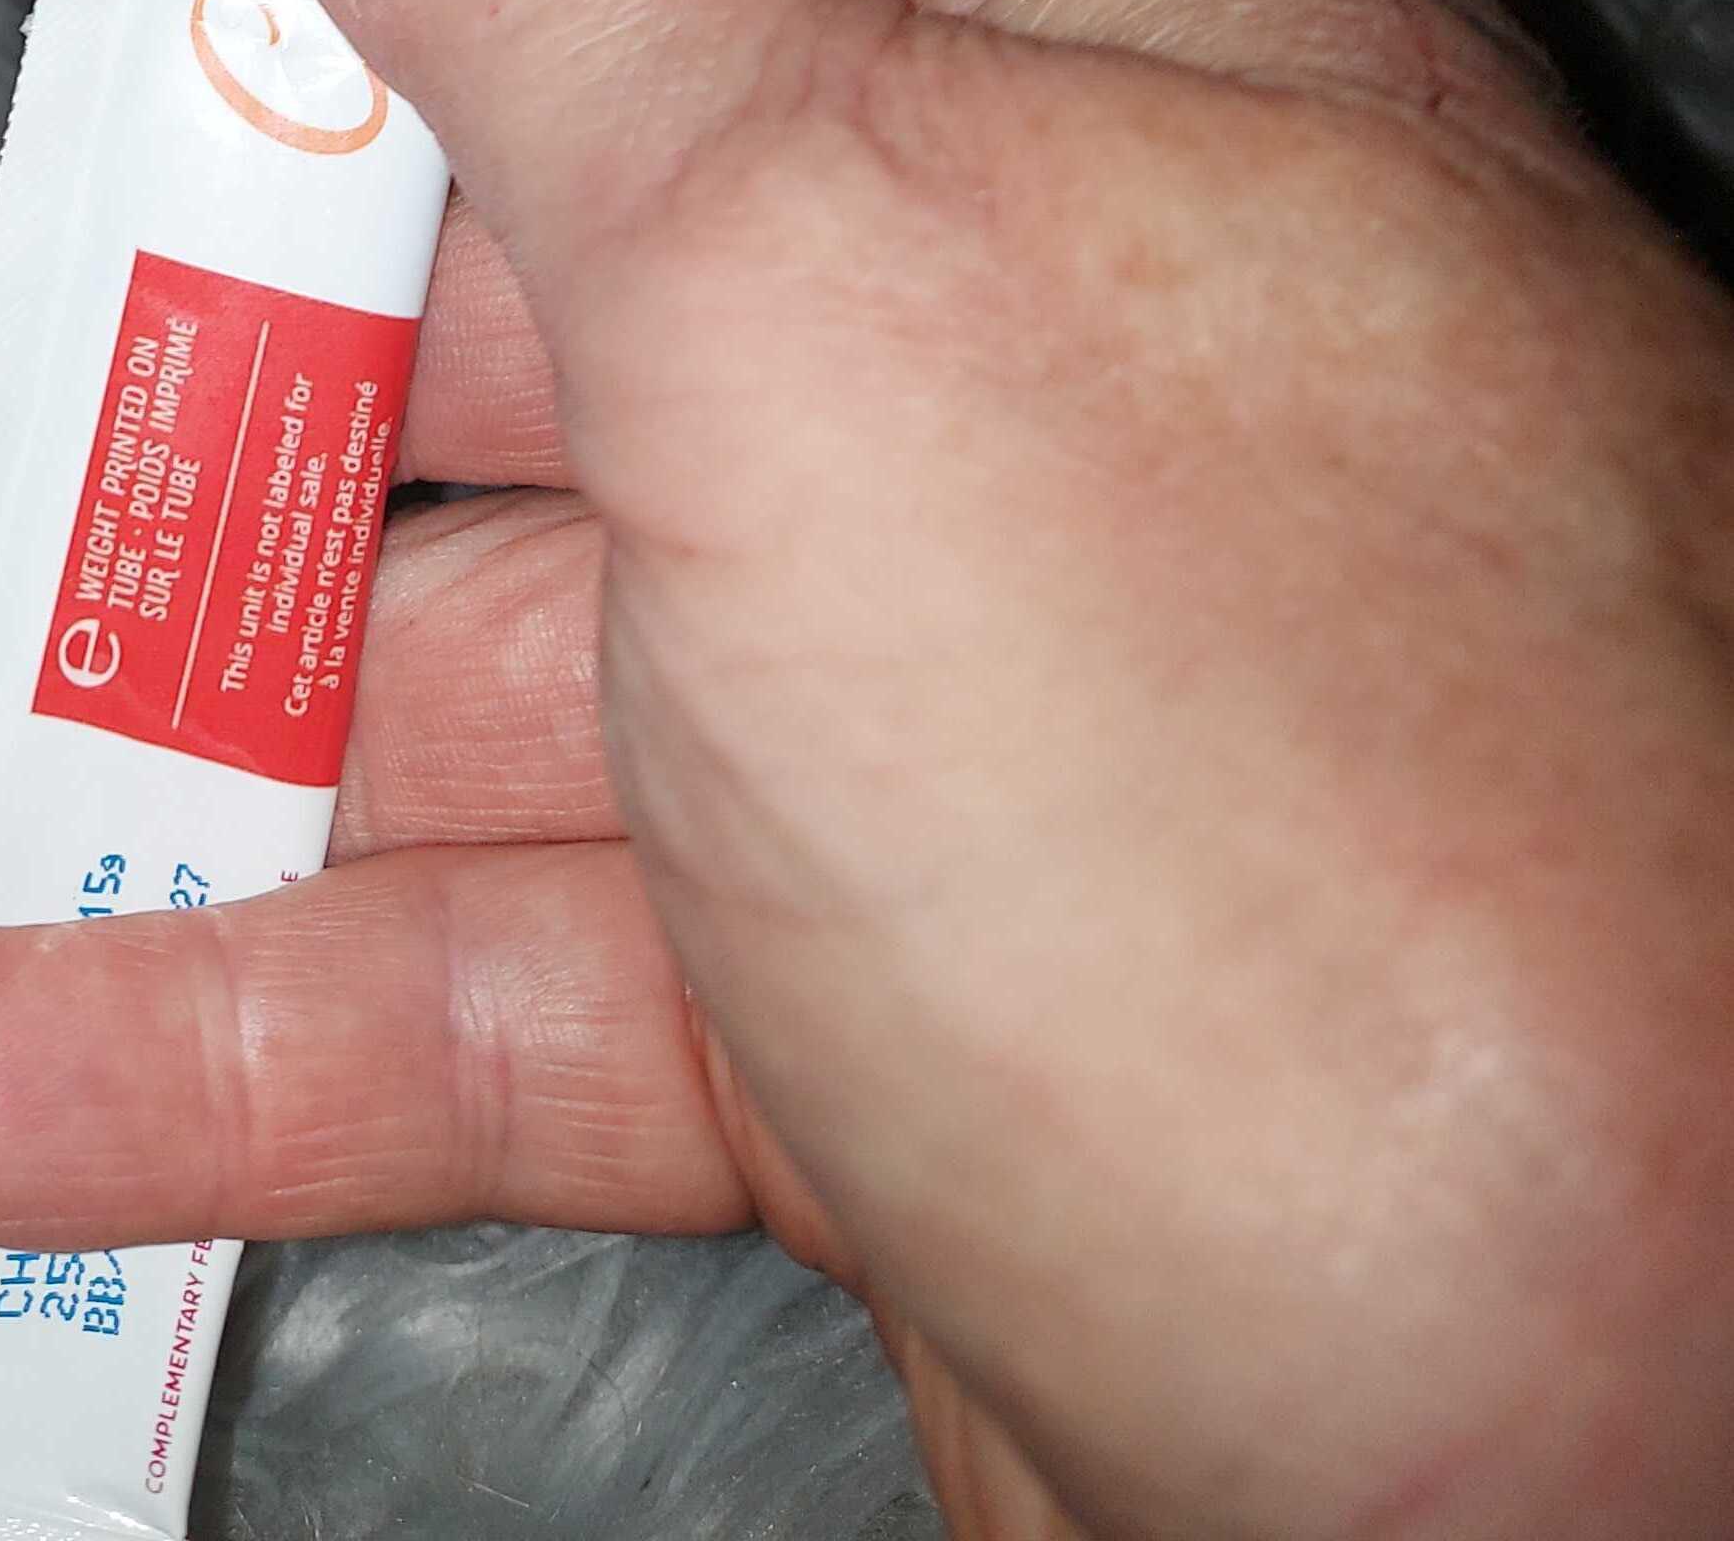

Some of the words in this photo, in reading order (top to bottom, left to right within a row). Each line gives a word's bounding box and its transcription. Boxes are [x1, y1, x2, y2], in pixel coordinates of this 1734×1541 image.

[148, 316, 198, 433] IMPRIMÉ
[284, 372, 313, 412] for
[340, 380, 378, 474] destiné
[75, 500, 120, 601] WEIGHT
[100, 385, 148, 497] PRINTED
[127, 336, 159, 377] ON
[129, 439, 170, 521] POIDS
[161, 454, 201, 520] TUBE
[262, 416, 304, 510] labeled
[332, 479, 356, 526] pas
[154, 529, 185, 560] LE
[257, 514, 283, 557] not
[267, 511, 313, 635] individual
[299, 452, 328, 509] sale.
[316, 528, 346, 588] n'est
[107, 543, 146, 609] TUBE
[139, 567, 181, 622] SUR
[247, 561, 271, 583] is
[239, 587, 266, 639] unit
[299, 592, 331, 671] article
[334, 570, 362, 639] vente
[221, 642, 254, 693] This
[323, 645, 346, 668] la
[284, 675, 313, 717] Cet
[145, 1271, 205, 1494] COMPLEMENTARY
